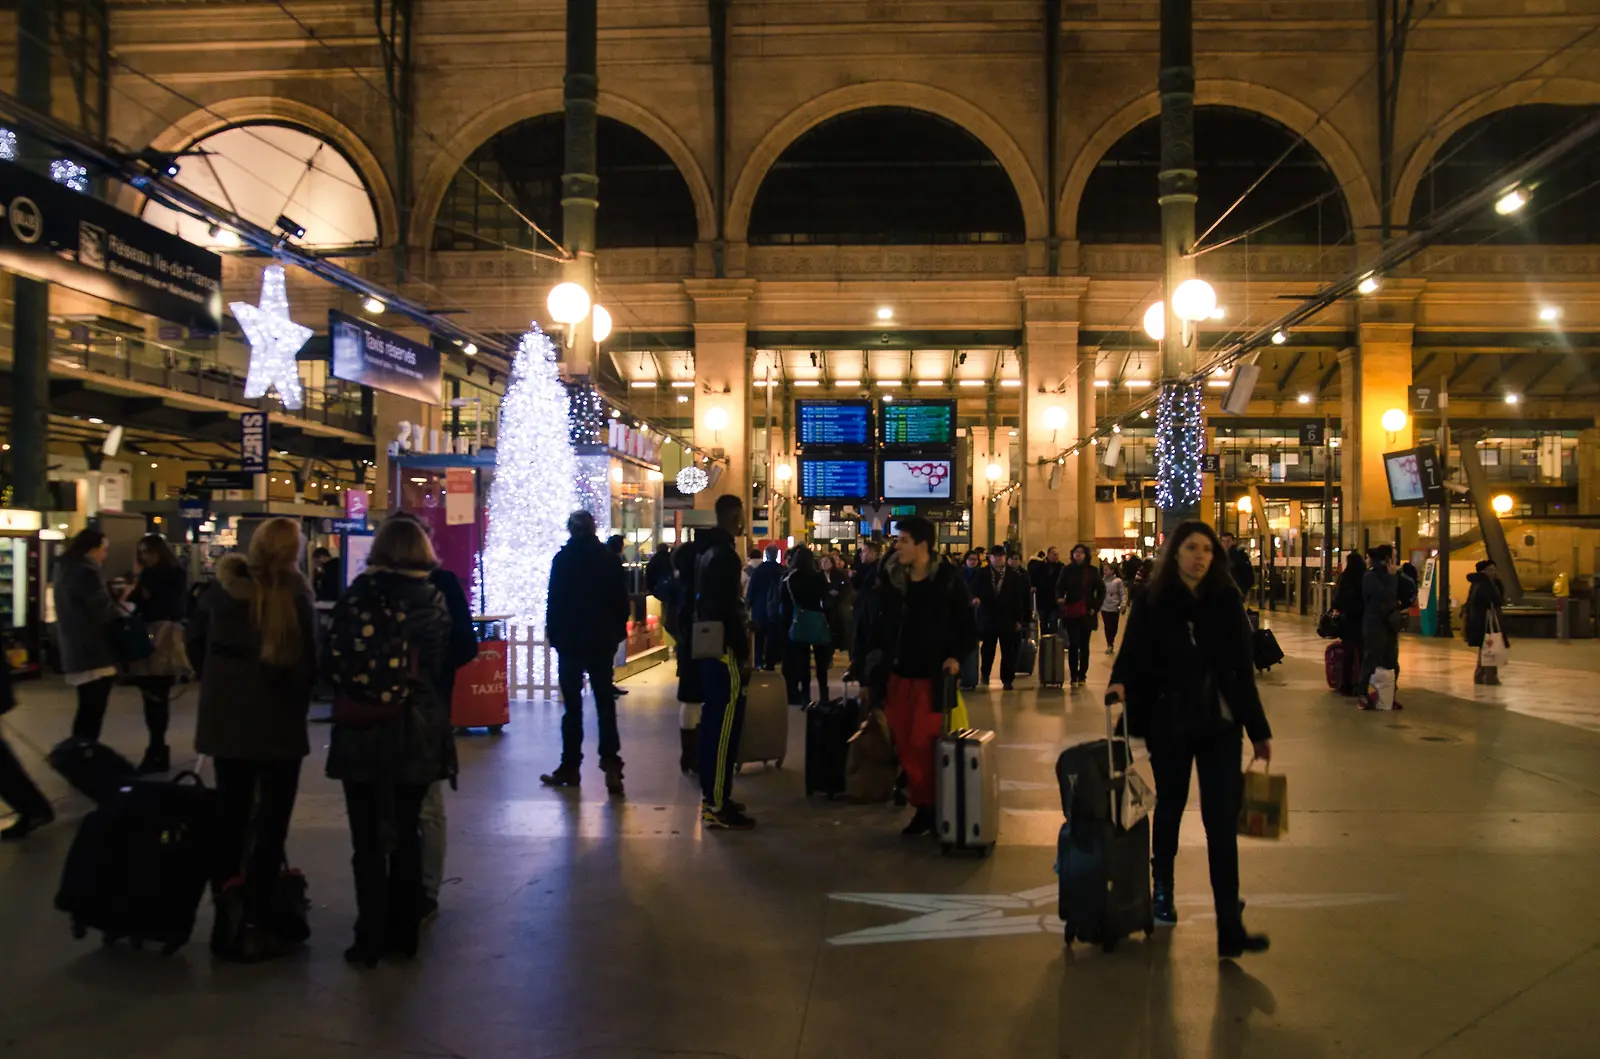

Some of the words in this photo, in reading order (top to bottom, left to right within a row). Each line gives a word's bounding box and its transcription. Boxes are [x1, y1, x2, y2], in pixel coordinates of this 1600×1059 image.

[364, 330, 384, 354] Taxis
[1418, 395, 1428, 409] 7
[1307, 430, 1316, 440] 6
[1207, 461, 1214, 470] 5
[471, 682, 504, 695] TAXIS
